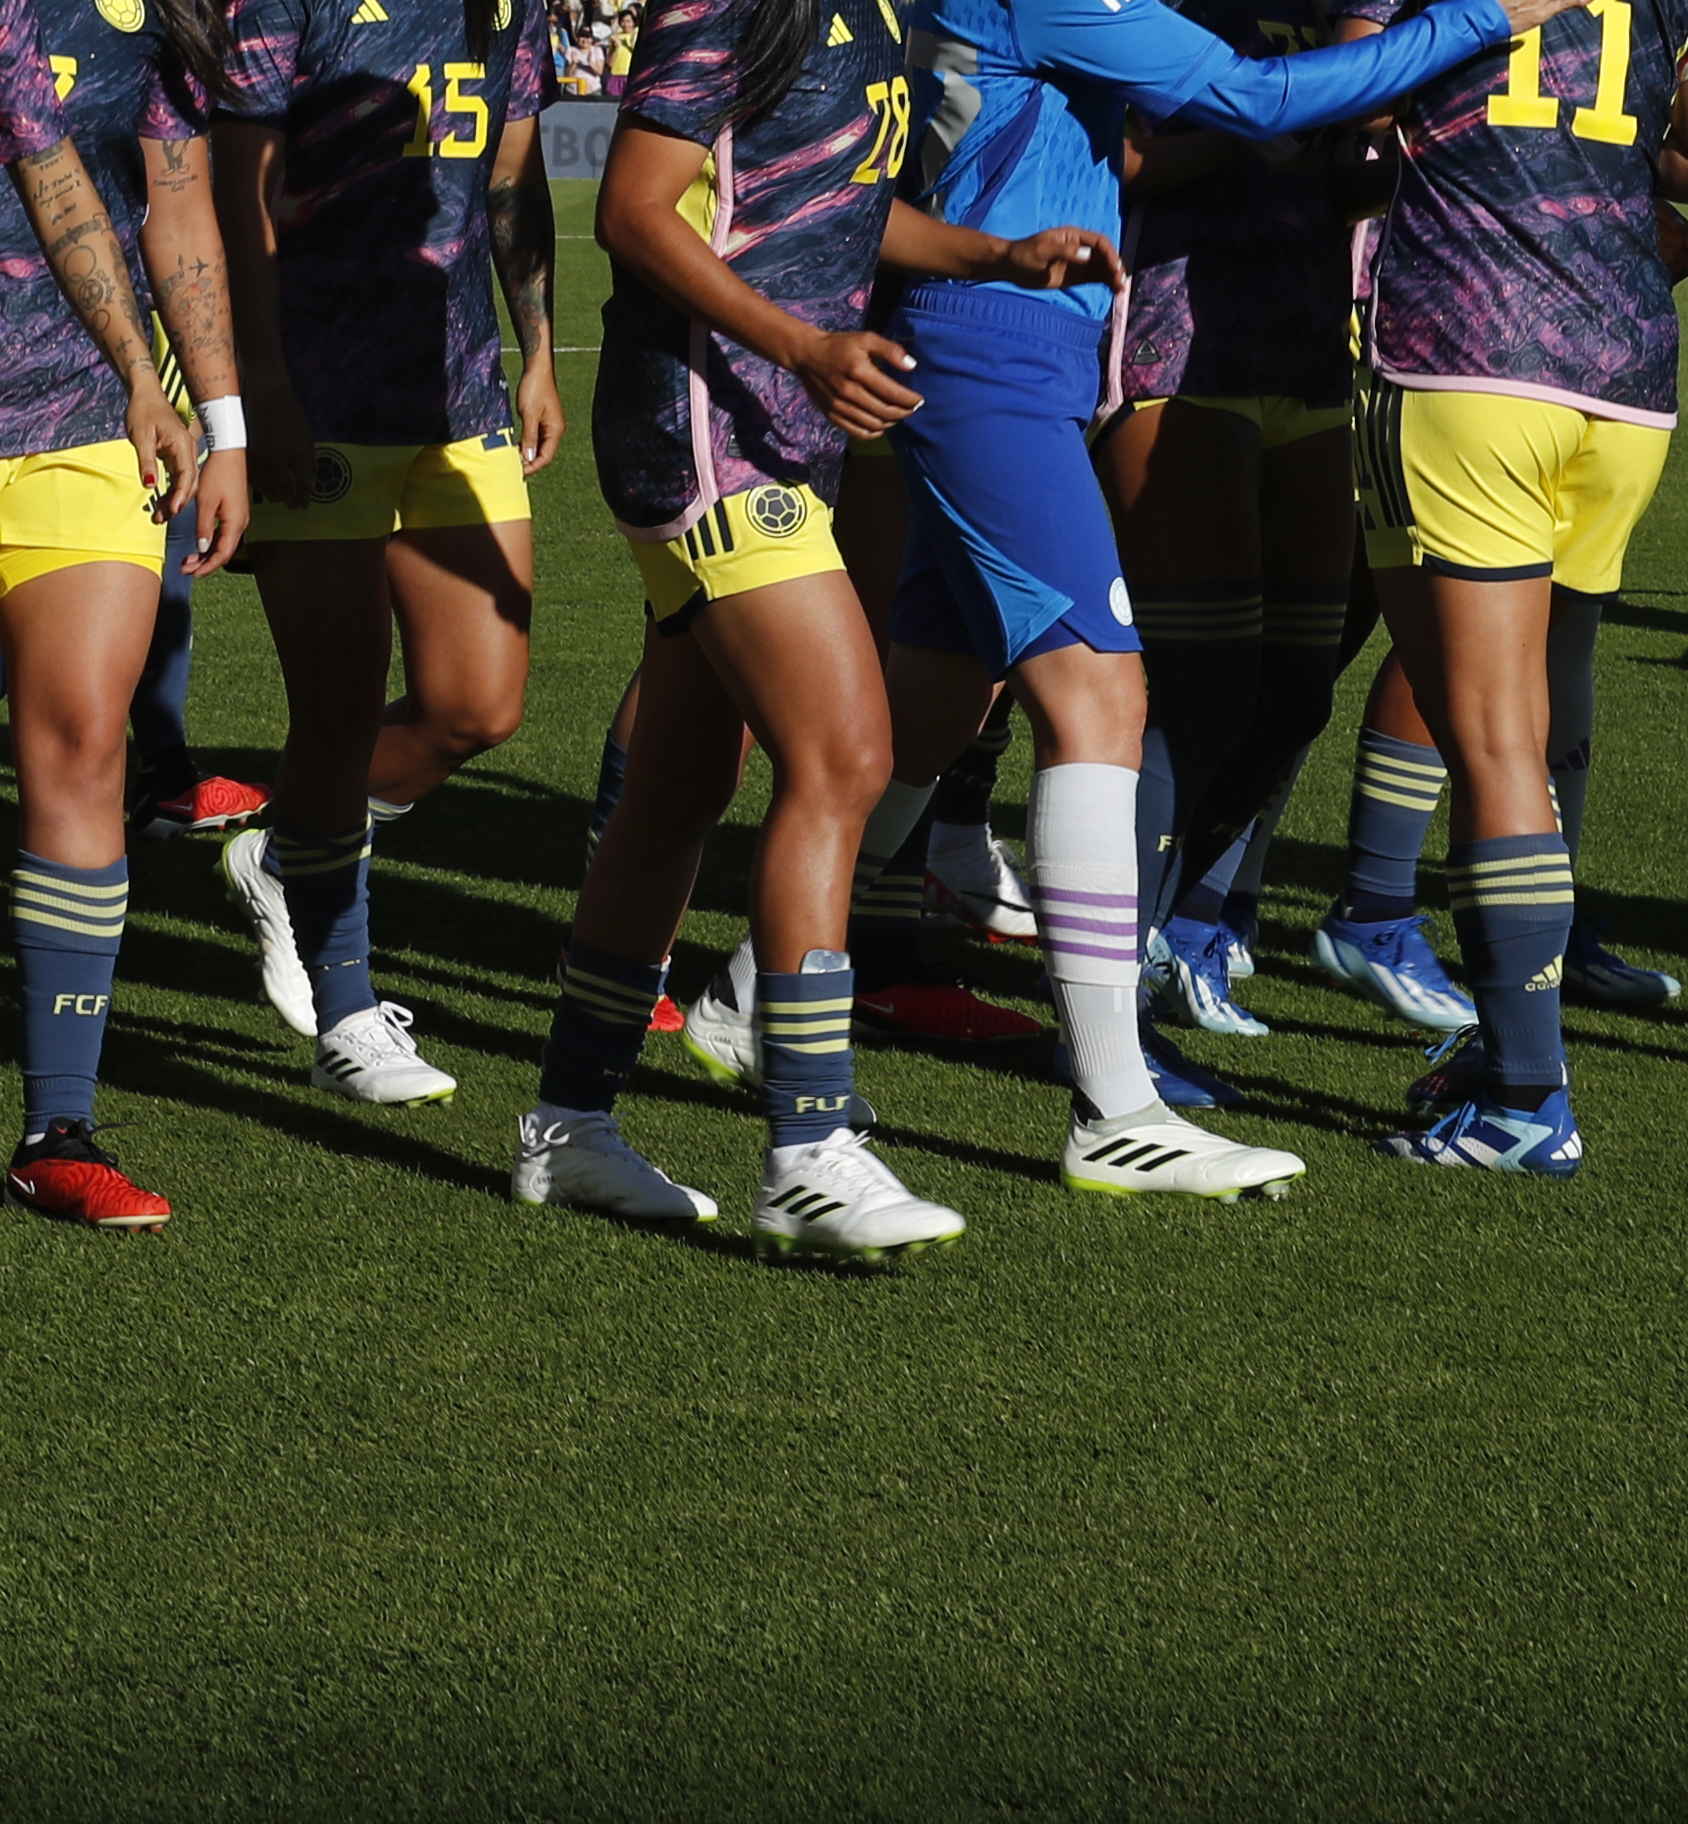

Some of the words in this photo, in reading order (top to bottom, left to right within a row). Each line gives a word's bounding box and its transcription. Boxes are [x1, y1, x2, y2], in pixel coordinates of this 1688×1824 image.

[403, 62, 489, 158] 15
[849, 75, 911, 184] 28
[53, 993, 109, 1016] FCF
